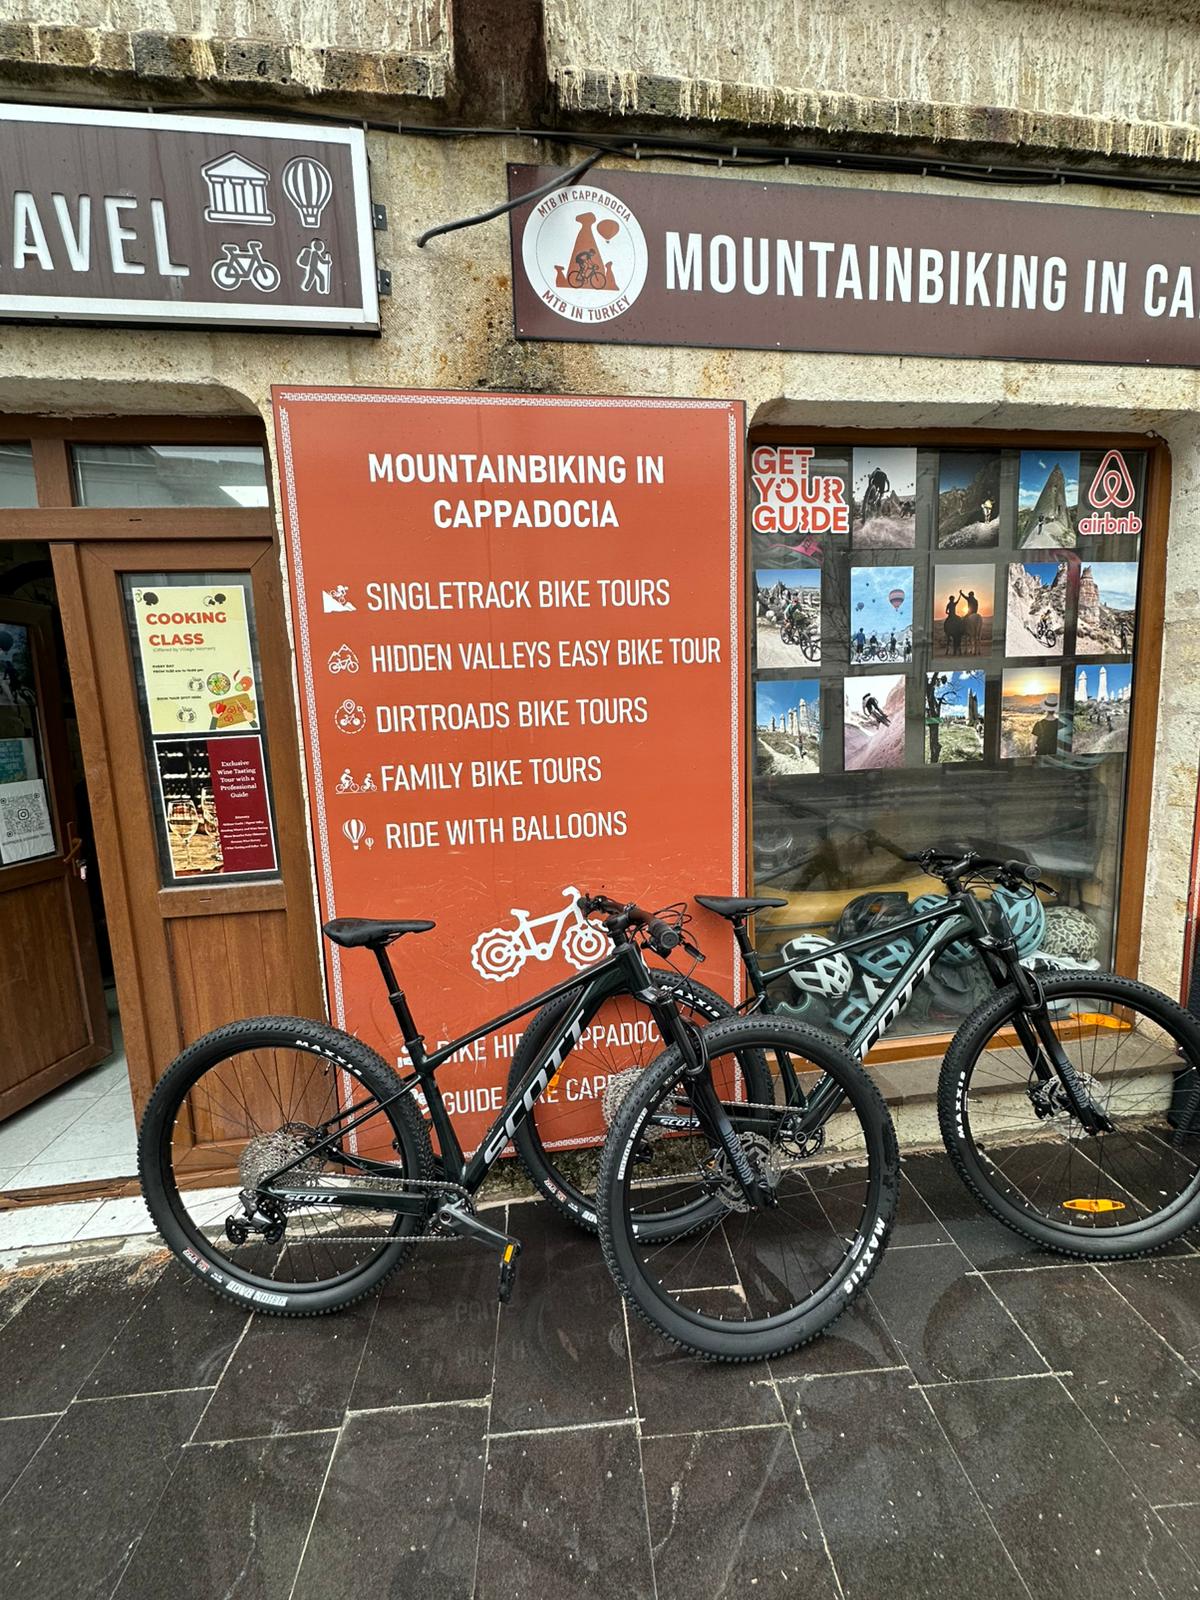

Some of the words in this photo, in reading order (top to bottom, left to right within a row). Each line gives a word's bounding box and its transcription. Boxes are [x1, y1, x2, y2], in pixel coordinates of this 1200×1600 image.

[537, 196, 558, 217] MTB
[558, 191, 569, 203] IN
[572, 190, 632, 222] CAPPADOCIA
[0, 190, 190, 277] AVEL
[665, 231, 1067, 312] MOUNTAINBIKING
[1084, 260, 1127, 315] IN
[1144, 263, 1200, 319] CA
[542, 290, 566, 313] MTB
[571, 306, 583, 320] IN
[588, 295, 632, 321] TURKEY
[369, 454, 626, 483] MOUNTAINBIKING
[637, 456, 663, 483] IN
[753, 447, 814, 475] GET
[754, 477, 843, 503] YOUR
[434, 500, 619, 528] CAPPADOCIA
[754, 505, 848, 531] GUIDE
[1079, 512, 1141, 535] airbnb
[367, 581, 531, 611] SINGLETRACK
[539, 581, 590, 607] BIKE
[597, 579, 669, 606] TOURS
[146, 612, 227, 625] COOKING
[149, 633, 204, 646] CLASS
[372, 644, 451, 672] HIDDEN
[459, 641, 550, 669] VALLEYS
[559, 640, 610, 667] EASY
[618, 639, 663, 665] BIKE
[669, 638, 720, 663] TOUR
[377, 702, 509, 732] DIRTROADS
[519, 700, 569, 727] BIKE
[576, 697, 647, 724] TOURS
[234, 767, 256, 775] Tasting
[382, 763, 462, 791] FAMILY
[472, 760, 522, 787] BIKE
[529, 756, 601, 784] TOURS
[220, 783, 257, 791] Professional
[387, 822, 439, 848] RIDE
[446, 818, 503, 845] WITH
[513, 811, 626, 841] BALLOONS
[660, 984, 721, 1019] MAXXIS
[853, 949, 935, 1061] COTT
[573, 1020, 664, 1051] PPADOC
[295, 1039, 362, 1076] MAXXIS
[442, 1086, 503, 1116] GUIDE
[484, 1008, 585, 1164] SCOTT
[284, 1193, 338, 1203] SCOTT
[843, 1216, 886, 1295] MAXXIS
